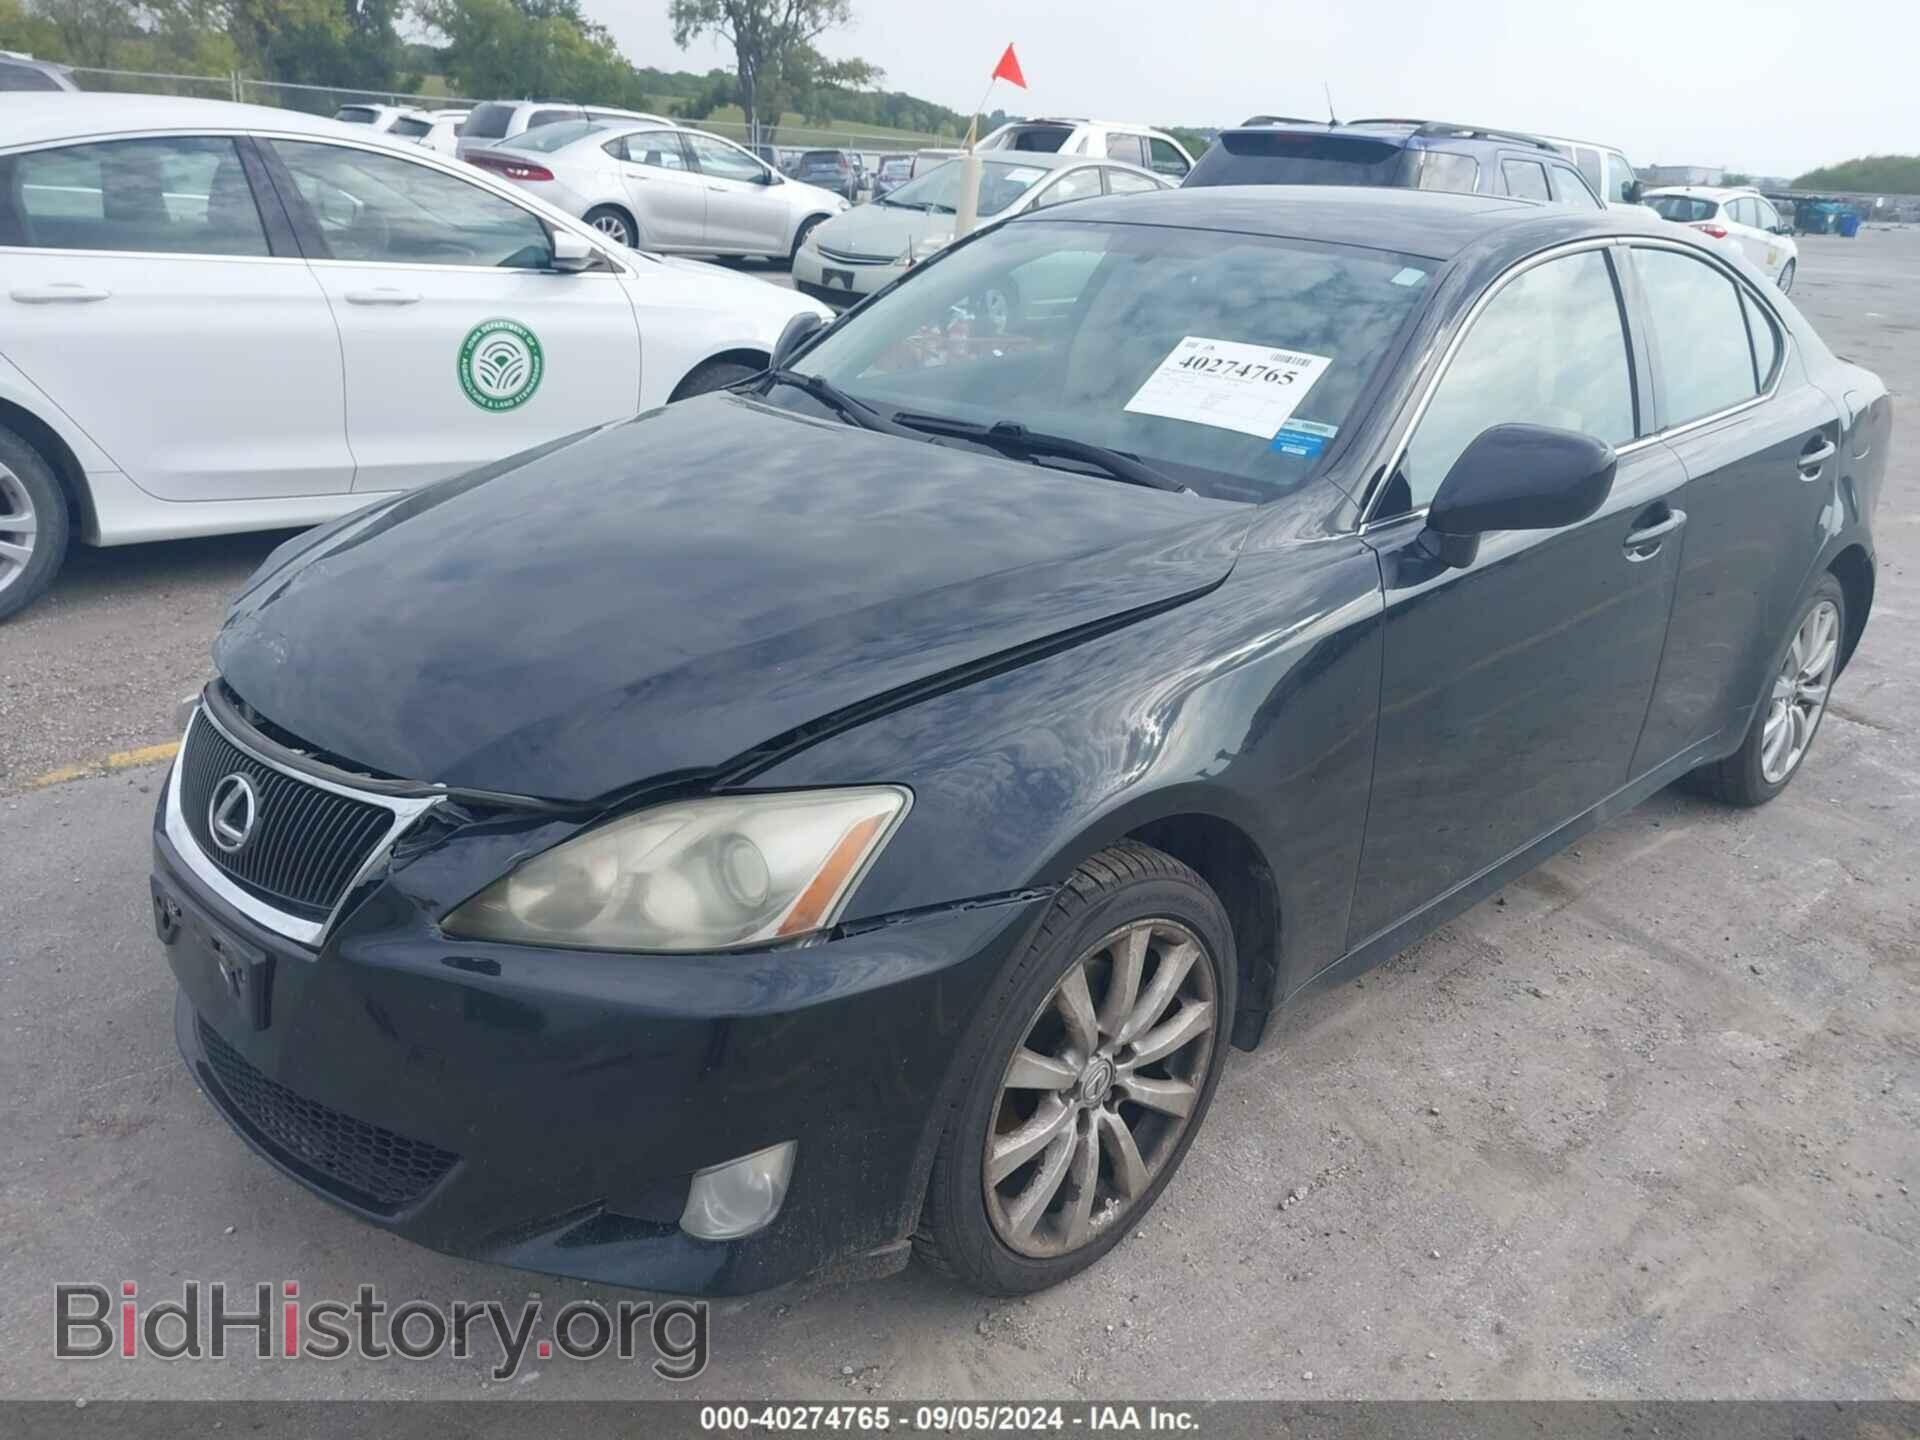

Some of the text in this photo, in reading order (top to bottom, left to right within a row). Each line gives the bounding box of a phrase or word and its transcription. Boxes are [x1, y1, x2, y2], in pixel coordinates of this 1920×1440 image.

[481, 321, 527, 337] DEPARTMENT
[526, 336, 536, 347] OF
[1178, 354, 1299, 386] 40274765
[494, 399, 514, 409] LAND
